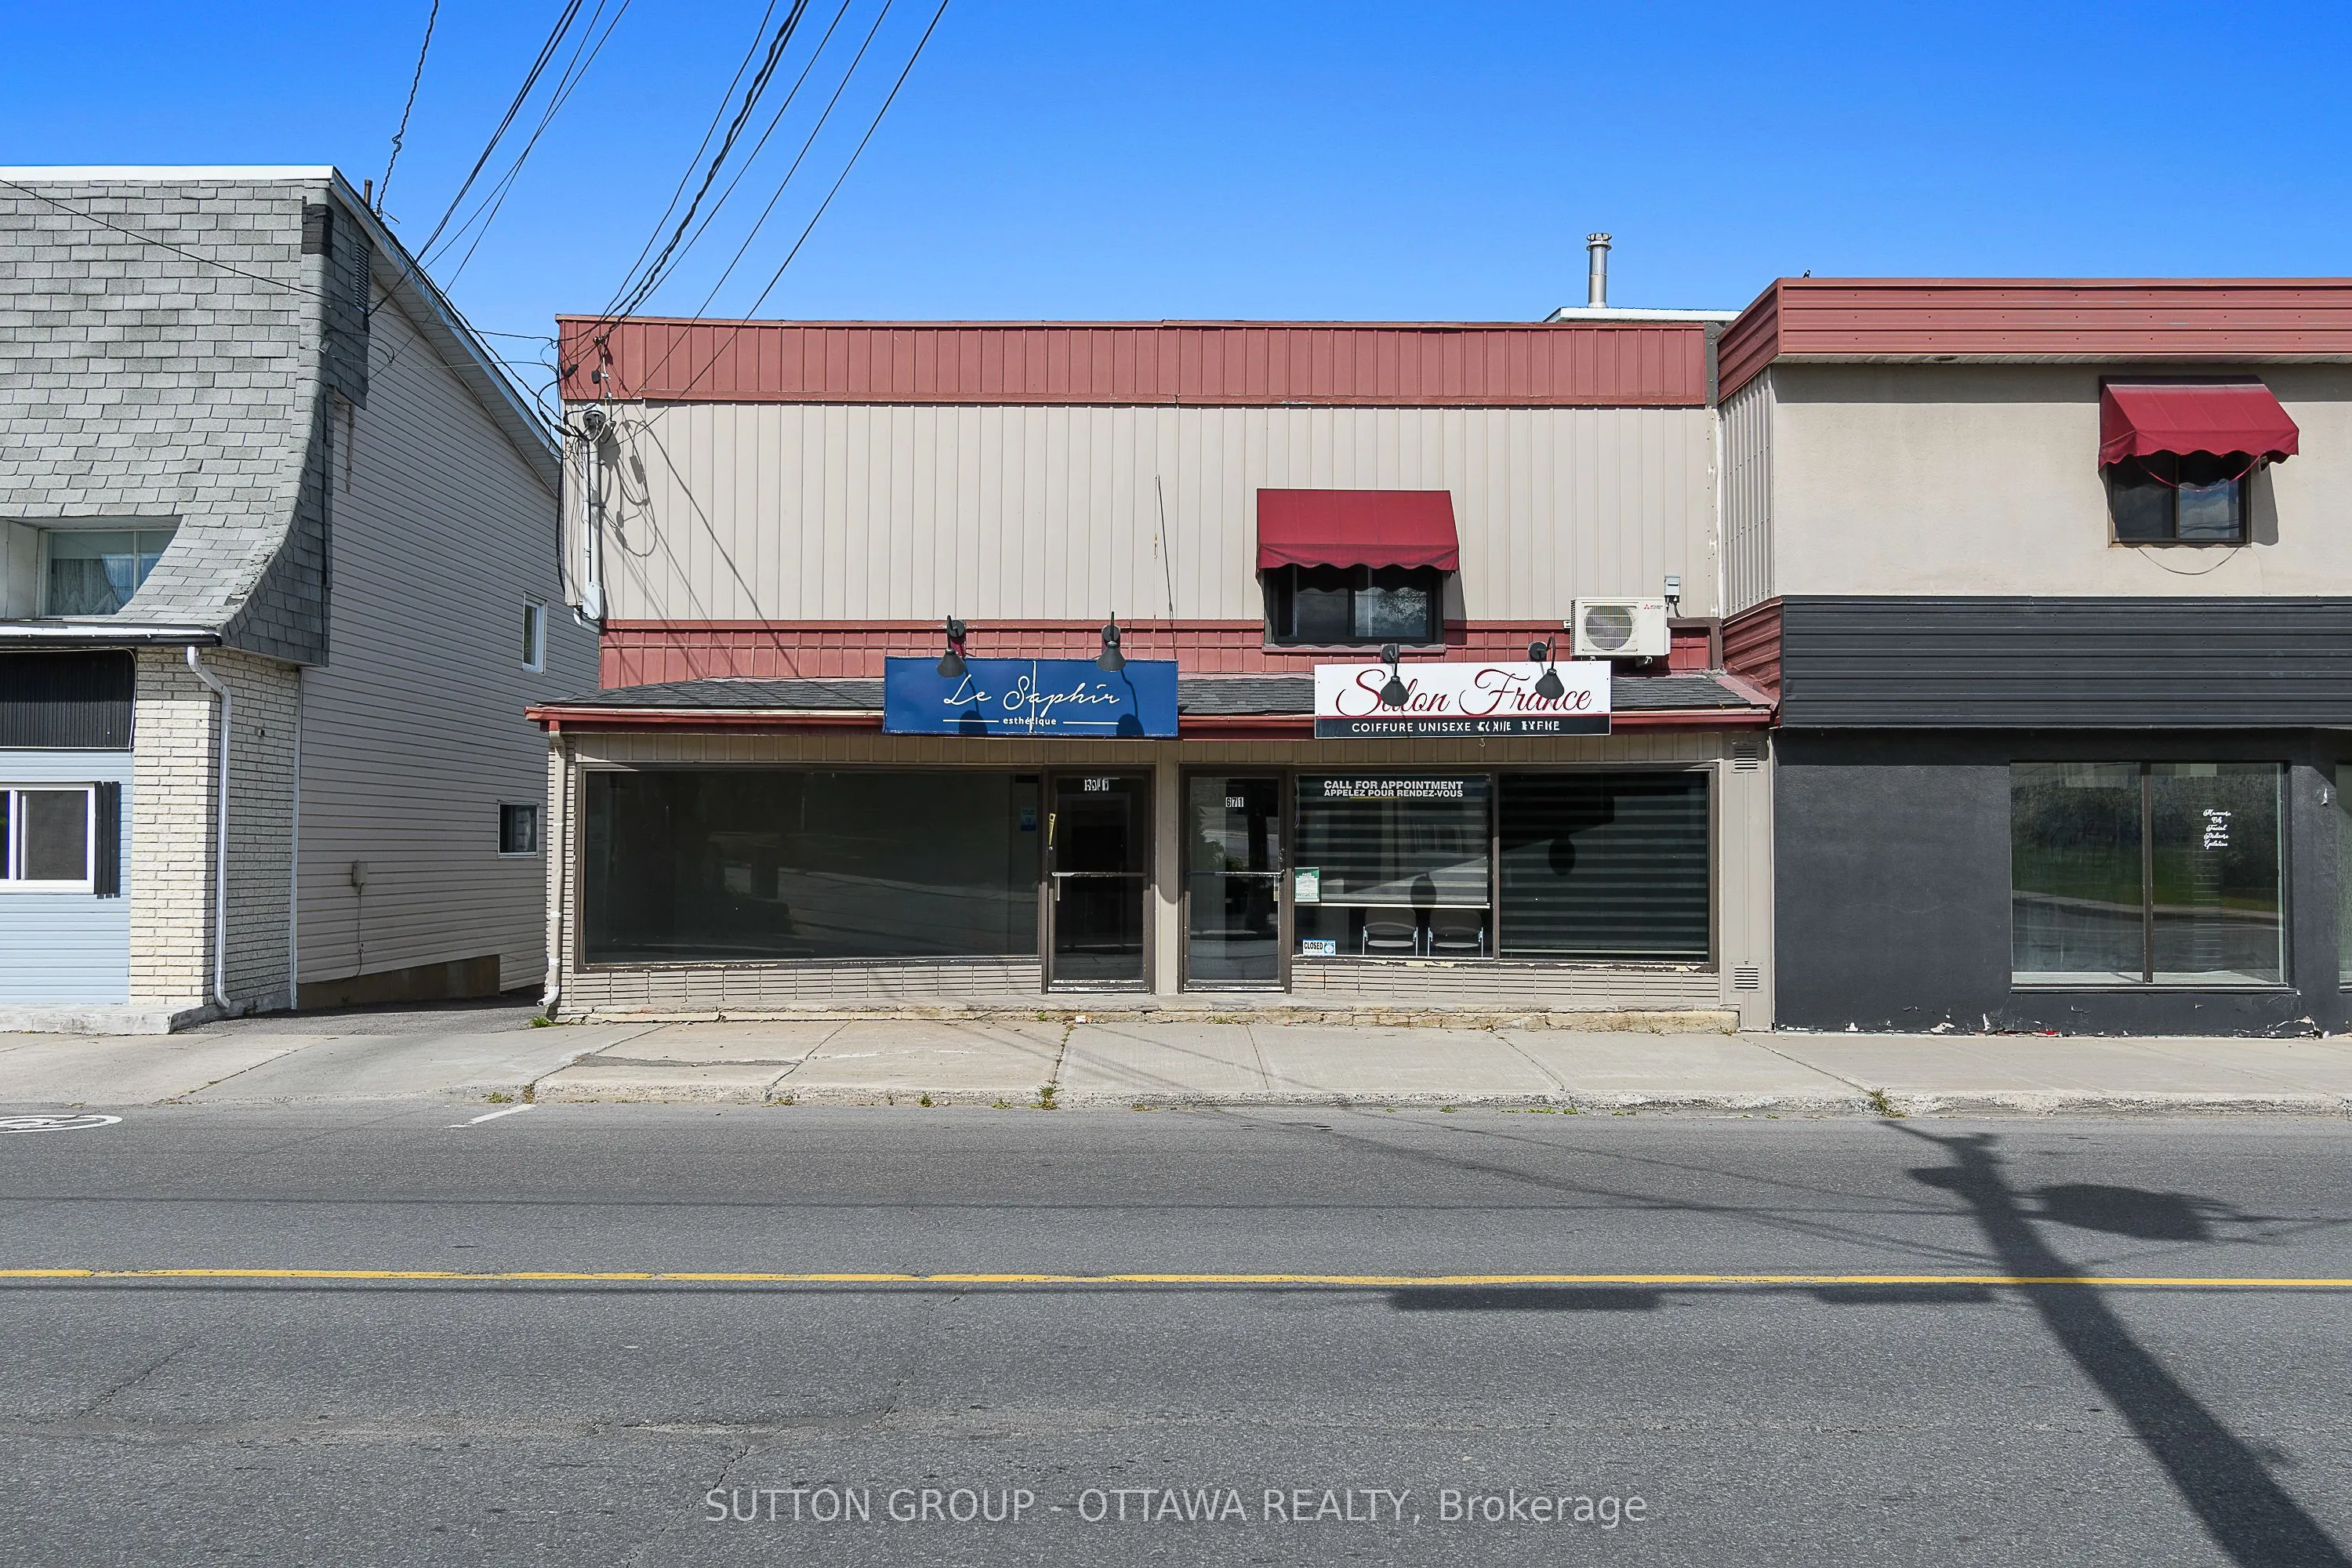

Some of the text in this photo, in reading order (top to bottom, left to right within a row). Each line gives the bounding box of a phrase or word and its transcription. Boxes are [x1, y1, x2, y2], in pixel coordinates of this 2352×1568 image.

[943, 673, 1120, 718] Le Saphir
[1459, 669, 1592, 716] France
[1003, 717, 1057, 727] esthétique
[1352, 722, 1414, 732] COIFFURE
[1418, 722, 1471, 731] UNISEXE
[1324, 780, 1464, 789] CALL FOR APPOINTMENT
[1226, 797, 1243, 807] 671
[1304, 942, 1323, 950] CLOSED
